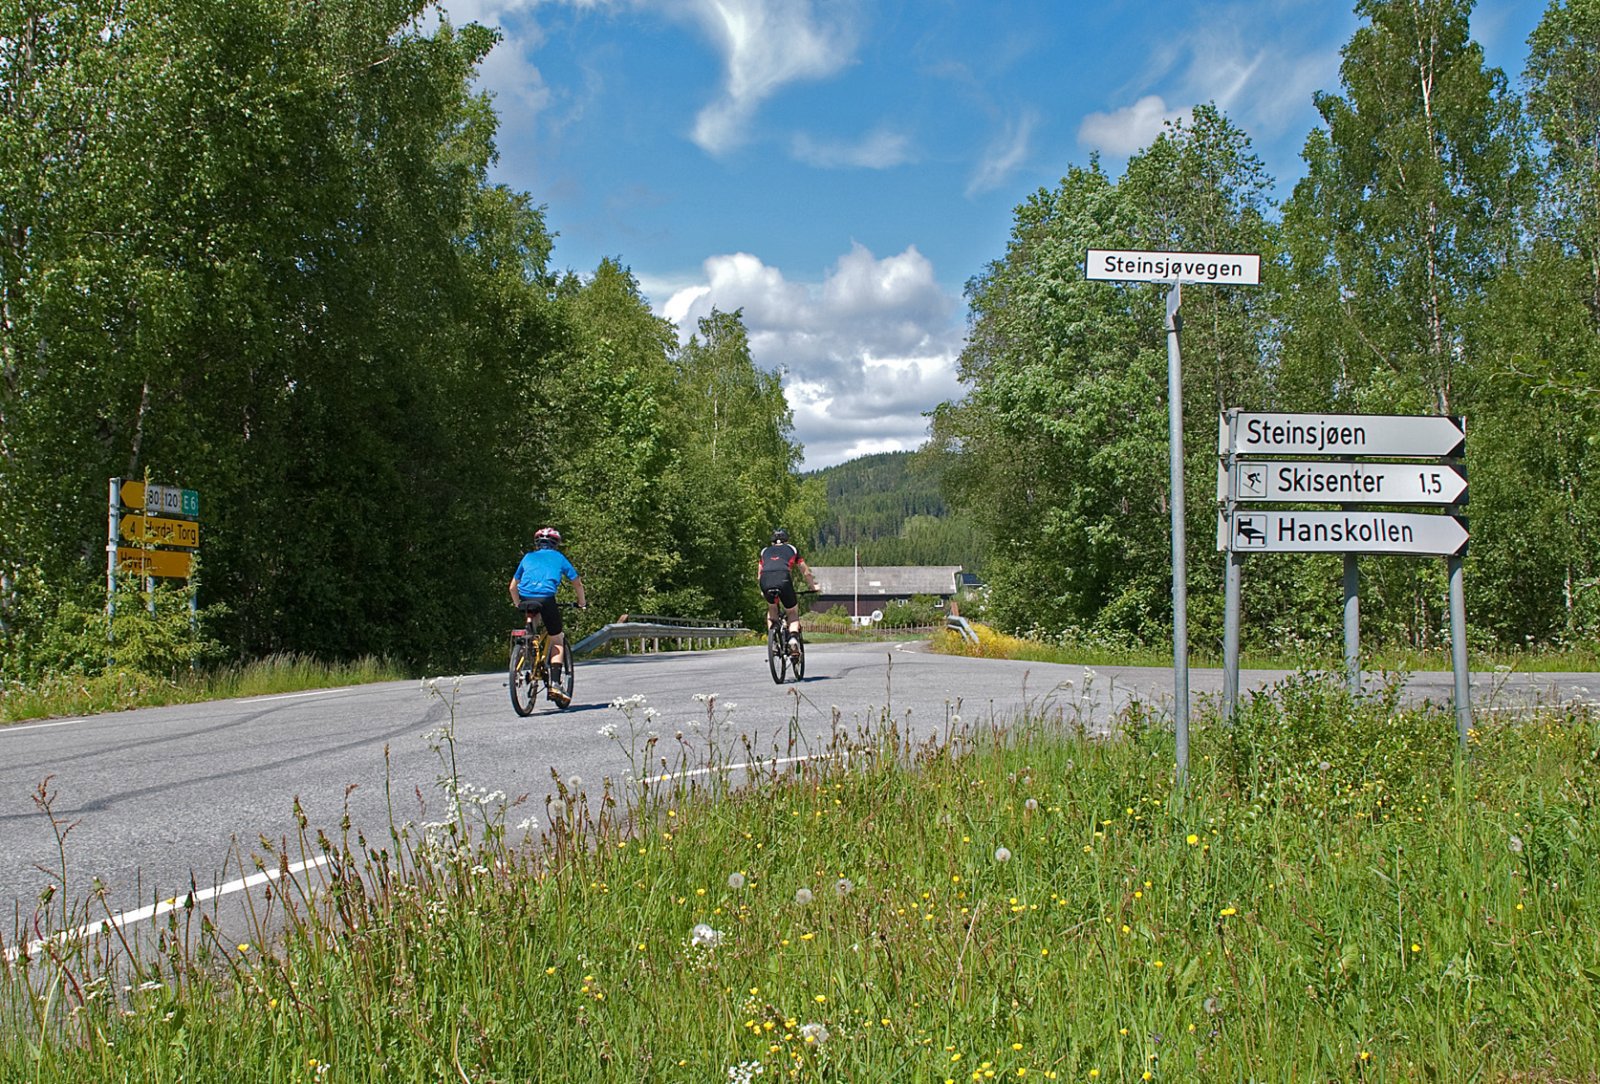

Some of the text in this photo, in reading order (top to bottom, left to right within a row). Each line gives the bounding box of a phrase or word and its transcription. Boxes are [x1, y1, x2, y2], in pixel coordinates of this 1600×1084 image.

[1104, 255, 1242, 280] Steinsjøvegen
[1247, 419, 1366, 451] Steinsjøen
[1278, 467, 1442, 496] Skisenter 1,5
[165, 492, 178, 508] 120
[130, 521, 135, 533] 4
[177, 524, 196, 545] Torg
[1278, 517, 1413, 543] Hanskollen
